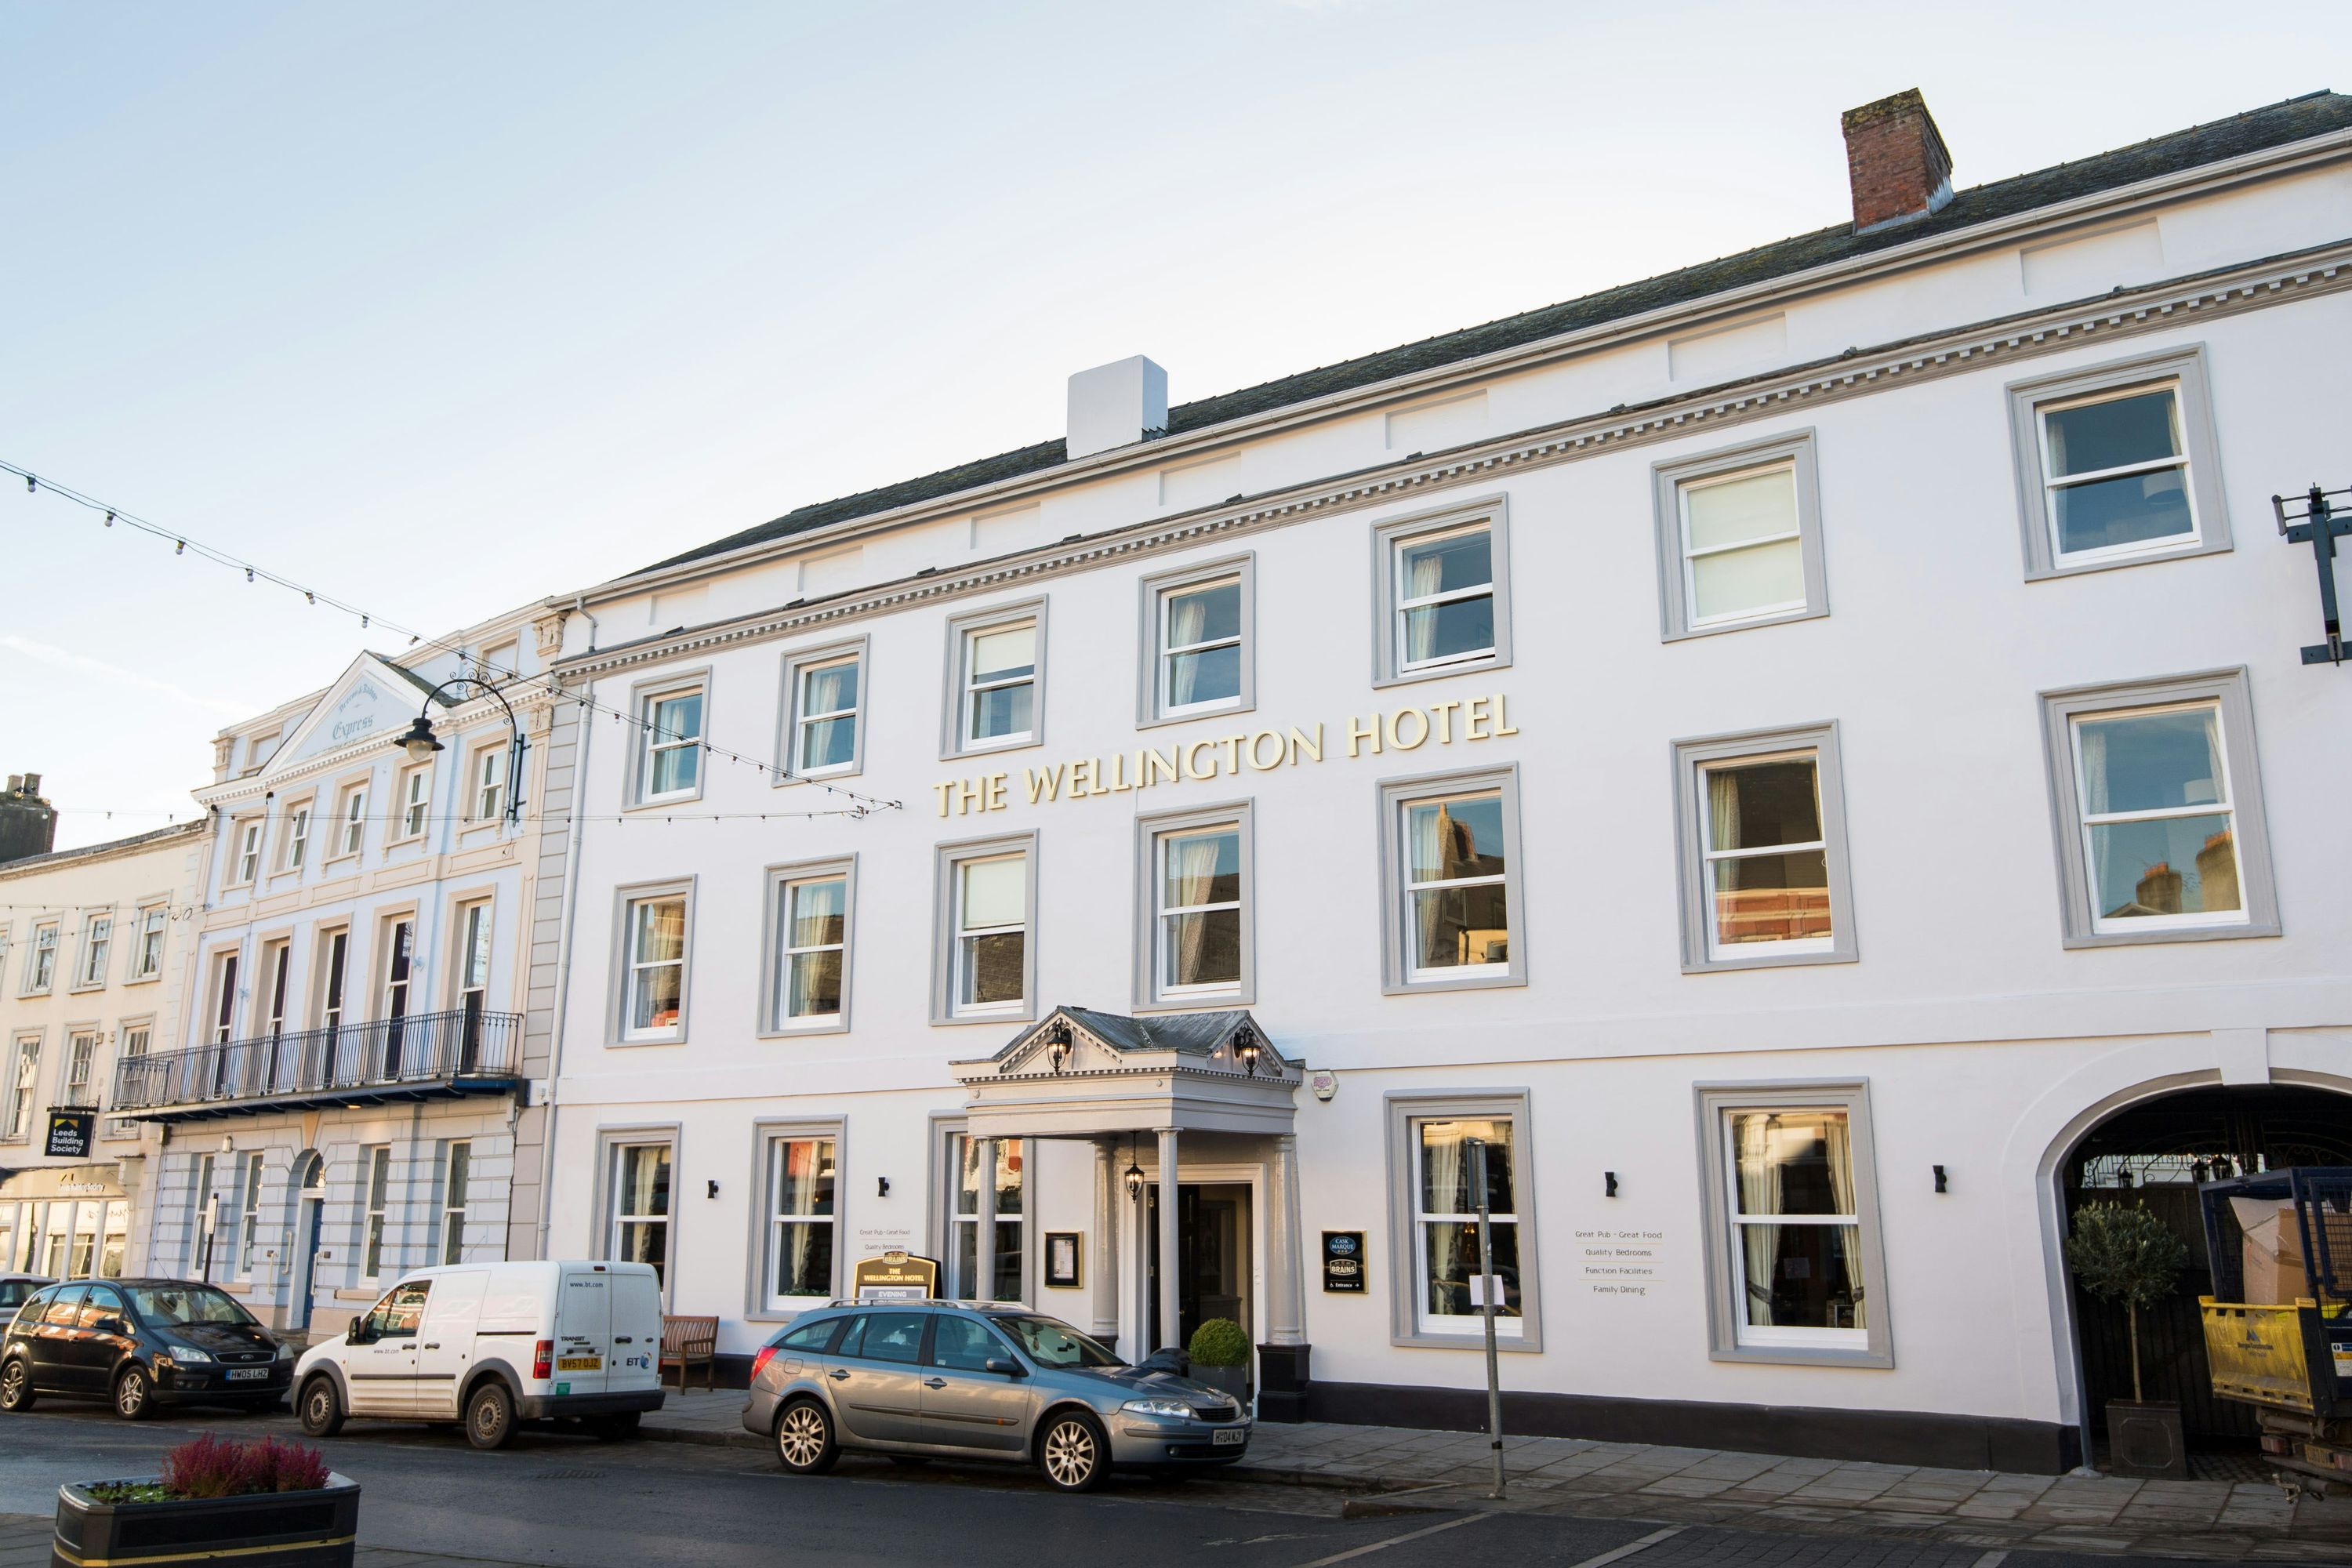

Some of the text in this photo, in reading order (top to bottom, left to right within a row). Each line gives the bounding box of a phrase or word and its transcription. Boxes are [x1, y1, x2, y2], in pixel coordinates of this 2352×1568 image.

[934, 693, 1519, 817] THE WELLINGTON HOTEL
[52, 1136, 84, 1146] Building
[51, 1145, 82, 1154] Society
[1585, 1249, 1613, 1258] Quality
[1593, 1286, 1646, 1296] Family Dining
[626, 1357, 640, 1366] BT
